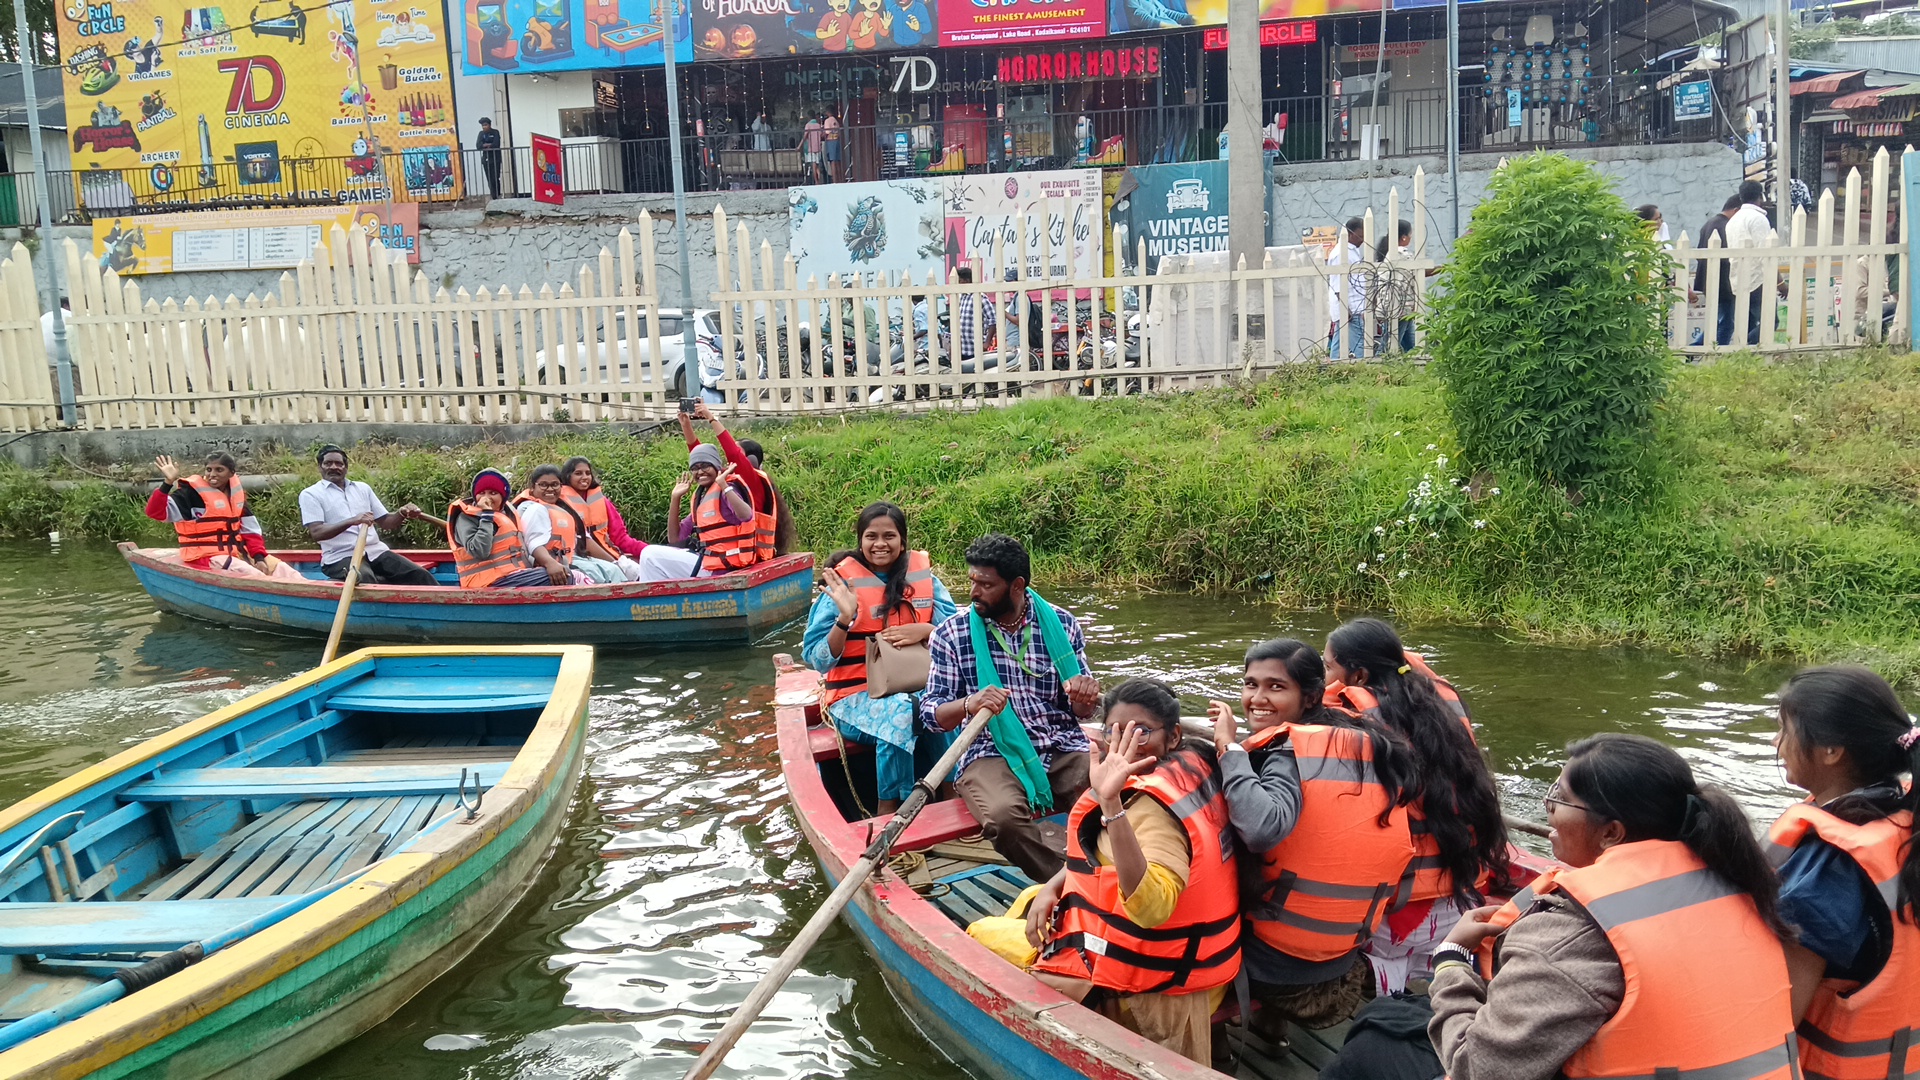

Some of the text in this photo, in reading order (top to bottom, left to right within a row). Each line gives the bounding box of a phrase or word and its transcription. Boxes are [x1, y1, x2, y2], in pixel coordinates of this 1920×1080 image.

[377, 11, 395, 22] Hang
[973, 8, 1086, 23] THE FINEST AMUSEMENT
[971, 32, 999, 41] Compound
[1017, 30, 1031, 38] Road
[1035, 28, 1066, 36] Kodaikanal
[1070, 26, 1091, 34] 624101
[1205, 23, 1314, 47] FU IRCLE
[219, 46, 238, 54] Play
[1384, 41, 1403, 50] FULL
[1405, 40, 1427, 48] BODY
[1394, 47, 1421, 56] CHAIR
[398, 66, 435, 76] Golden
[998, 46, 1160, 83] HORROR HOUSE
[141, 70, 172, 79] GAMES
[405, 73, 442, 83] Bucket
[784, 66, 885, 86] INFINITY
[890, 55, 937, 93] 7D
[217, 54, 286, 115] 7D
[136, 107, 177, 132] PAINTBALL
[223, 112, 291, 130] CINEMA
[331, 117, 362, 126] Ballon
[80, 126, 125, 140] Horror
[425, 127, 447, 135] Rings
[93, 136, 136, 149] House
[140, 150, 181, 162] ARCHERY
[243, 152, 272, 160] VORTEX
[1040, 179, 1080, 189] OUR EXQUISITE
[337, 186, 391, 203] GAMES
[1046, 188, 1082, 198] ECIALS ENU
[218, 211, 244, 219] RIDERS
[301, 207, 350, 215] ASSOCIATION
[379, 224, 403, 237] FN
[972, 203, 1091, 257] Capta's Kithe
[1148, 215, 1229, 237] VINTAGE
[1148, 236, 1229, 257] MUSEUM
[1033, 265, 1068, 277] RESURANT
